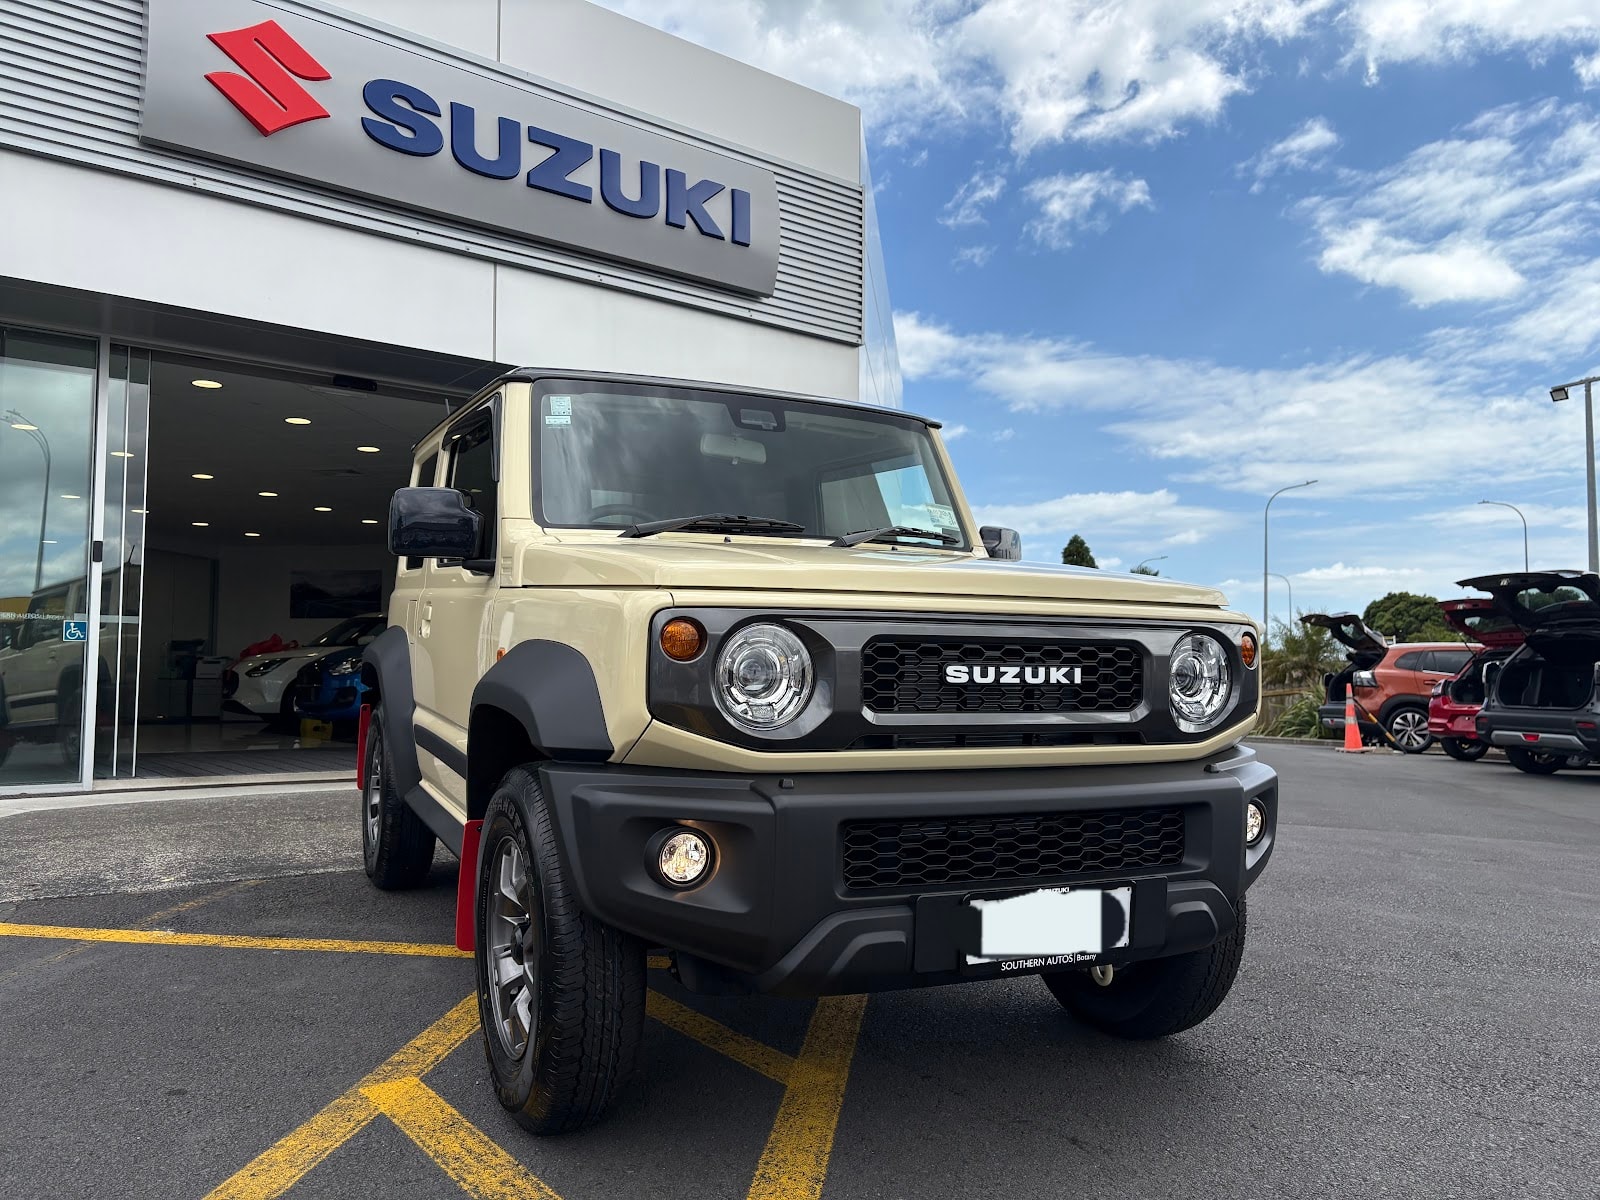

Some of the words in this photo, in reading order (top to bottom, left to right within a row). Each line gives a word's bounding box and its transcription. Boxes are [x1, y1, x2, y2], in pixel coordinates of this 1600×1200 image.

[361, 78, 751, 248] SUZUKI
[945, 665, 1082, 684] SUZUKI
[1000, 957, 1045, 971] SOUTHERN
[1046, 954, 1074, 966] AUTOS
[1076, 954, 1097, 962] Botany
